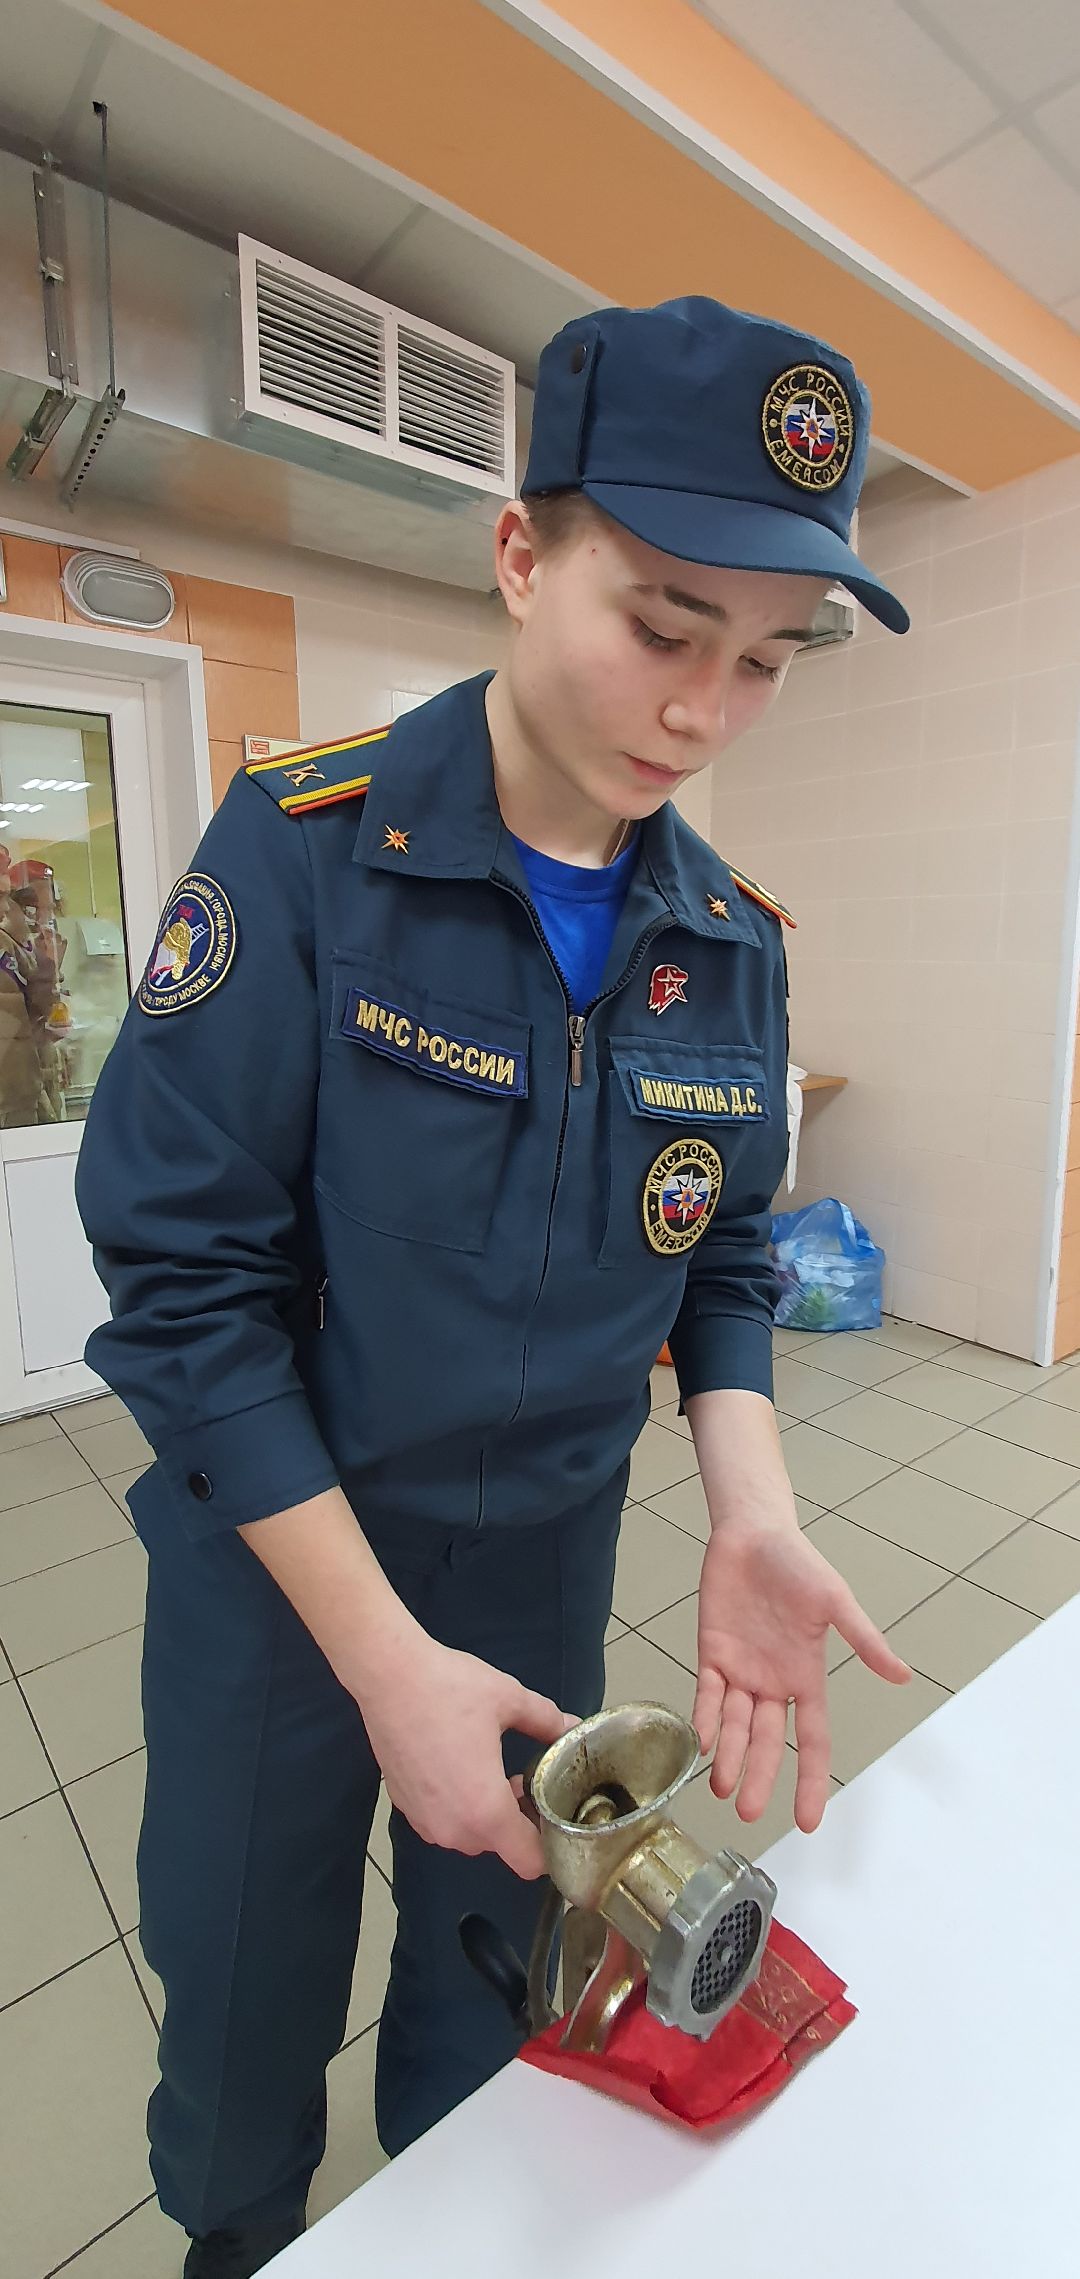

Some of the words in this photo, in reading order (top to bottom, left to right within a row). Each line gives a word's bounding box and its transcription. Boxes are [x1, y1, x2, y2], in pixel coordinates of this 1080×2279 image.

[770, 376, 800, 413] МЧС
[806, 373, 850, 437] РОССИИ
[209, 932, 229, 972] МОСКВЫ
[178, 973, 212, 1001] МОСКВЕ
[356, 999, 412, 1047] МЧС
[417, 1026, 515, 1086] РОССИИ
[639, 1076, 729, 1113] МИКИТИНА
[730, 1086, 763, 1117] Д.С.
[648, 1153, 676, 1195] МЧС
[678, 1144, 721, 1190] РОССИИ
